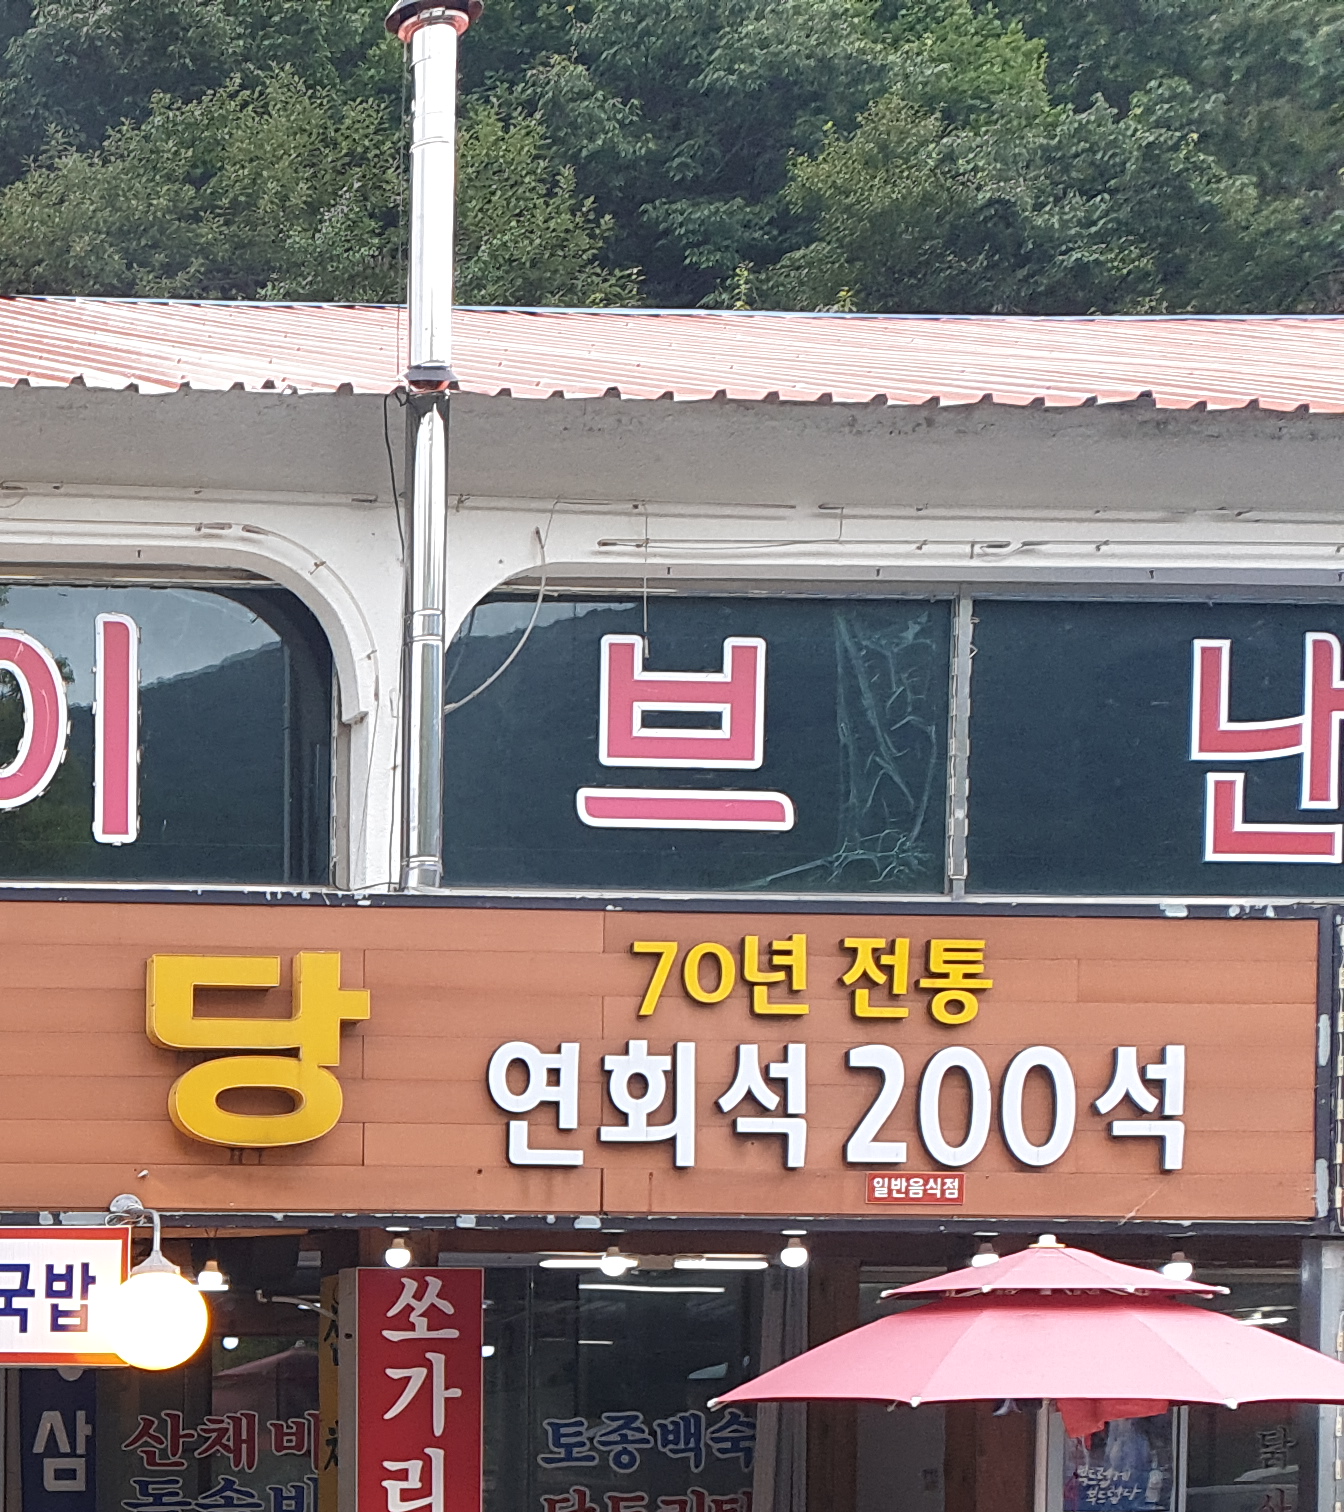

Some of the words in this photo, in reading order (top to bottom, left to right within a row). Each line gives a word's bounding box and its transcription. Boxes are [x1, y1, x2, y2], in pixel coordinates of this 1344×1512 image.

[631, 932, 811, 1018] 70년
[839, 936, 996, 1027] 전통
[486, 1038, 809, 1171] 연회석
[843, 1042, 1189, 1172] 200석
[871, 1174, 961, 1202] 일반음식점
[537, 1409, 757, 1474] 토종백숙
